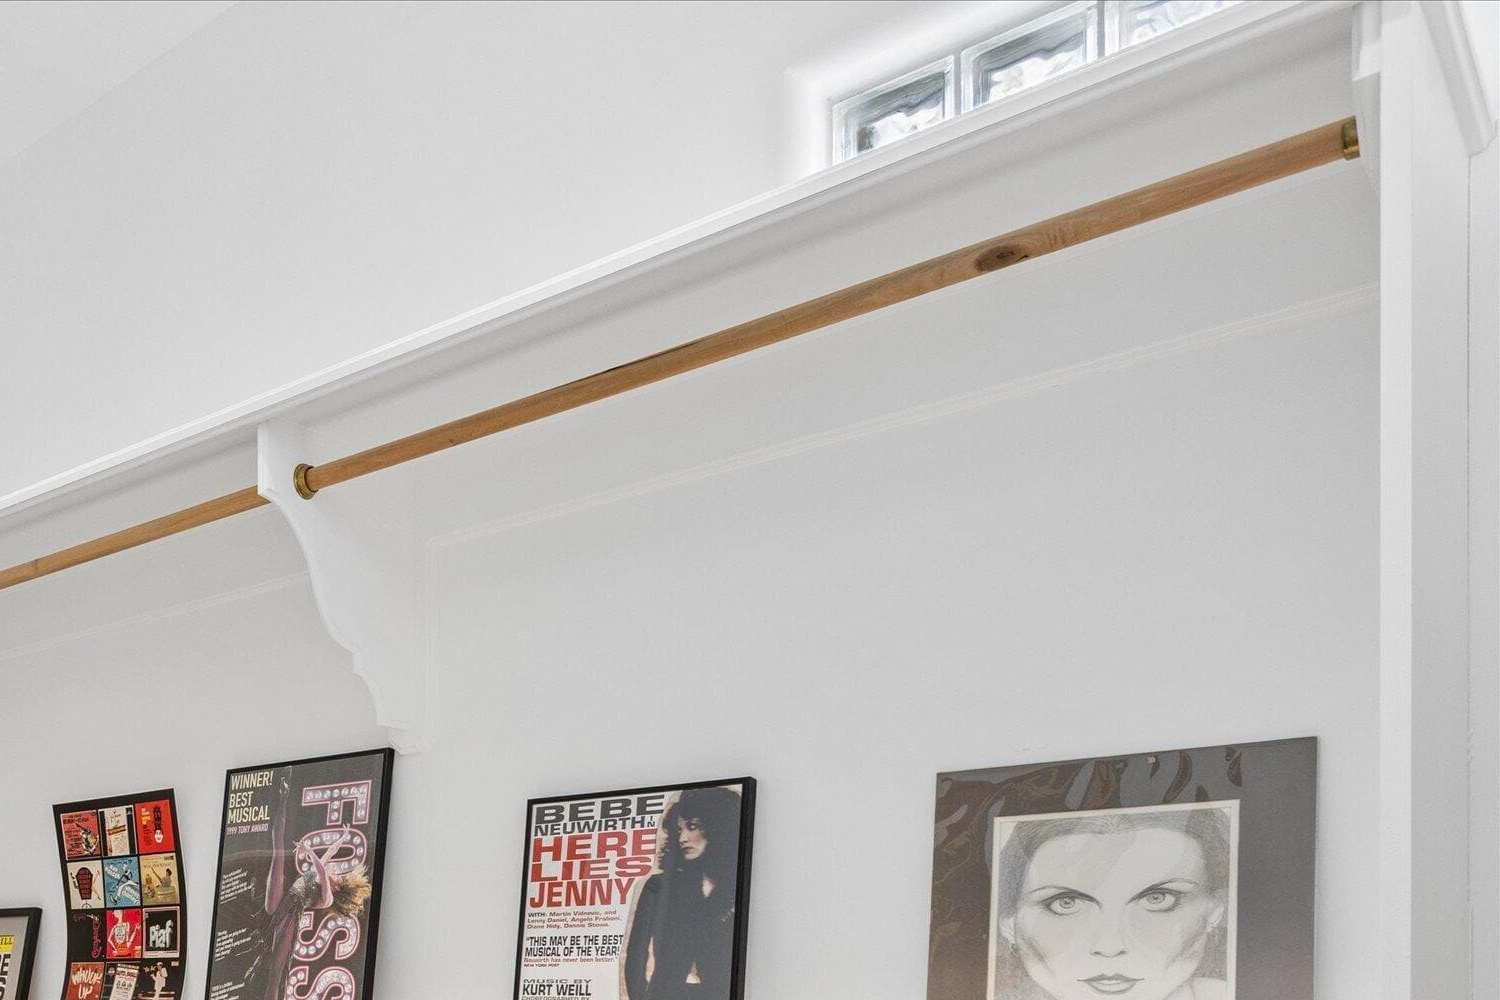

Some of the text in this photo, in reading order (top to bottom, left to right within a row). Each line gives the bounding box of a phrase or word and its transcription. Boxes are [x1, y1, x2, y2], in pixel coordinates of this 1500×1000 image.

[231, 771, 274, 790] WINNER!
[229, 791, 254, 808] BEST
[228, 806, 270, 824] MUSICAL
[536, 794, 665, 824] BEBE
[238, 825, 250, 834] TONY
[251, 824, 268, 832] AWARD
[534, 816, 646, 837] NEUWIRTH
[532, 828, 658, 862] HERE
[531, 857, 652, 882] LIES
[530, 878, 635, 908] JENNY
[150, 920, 174, 948] Piaf
[550, 936, 568, 946] MAY
[570, 936, 580, 946] BE
[584, 935, 599, 945] THE
[602, 934, 624, 945] BEST
[525, 946, 620, 957] MUSICAL OF THE YEAR!
[78, 984, 93, 1000] UP
[522, 984, 592, 996] KURT WEILL
